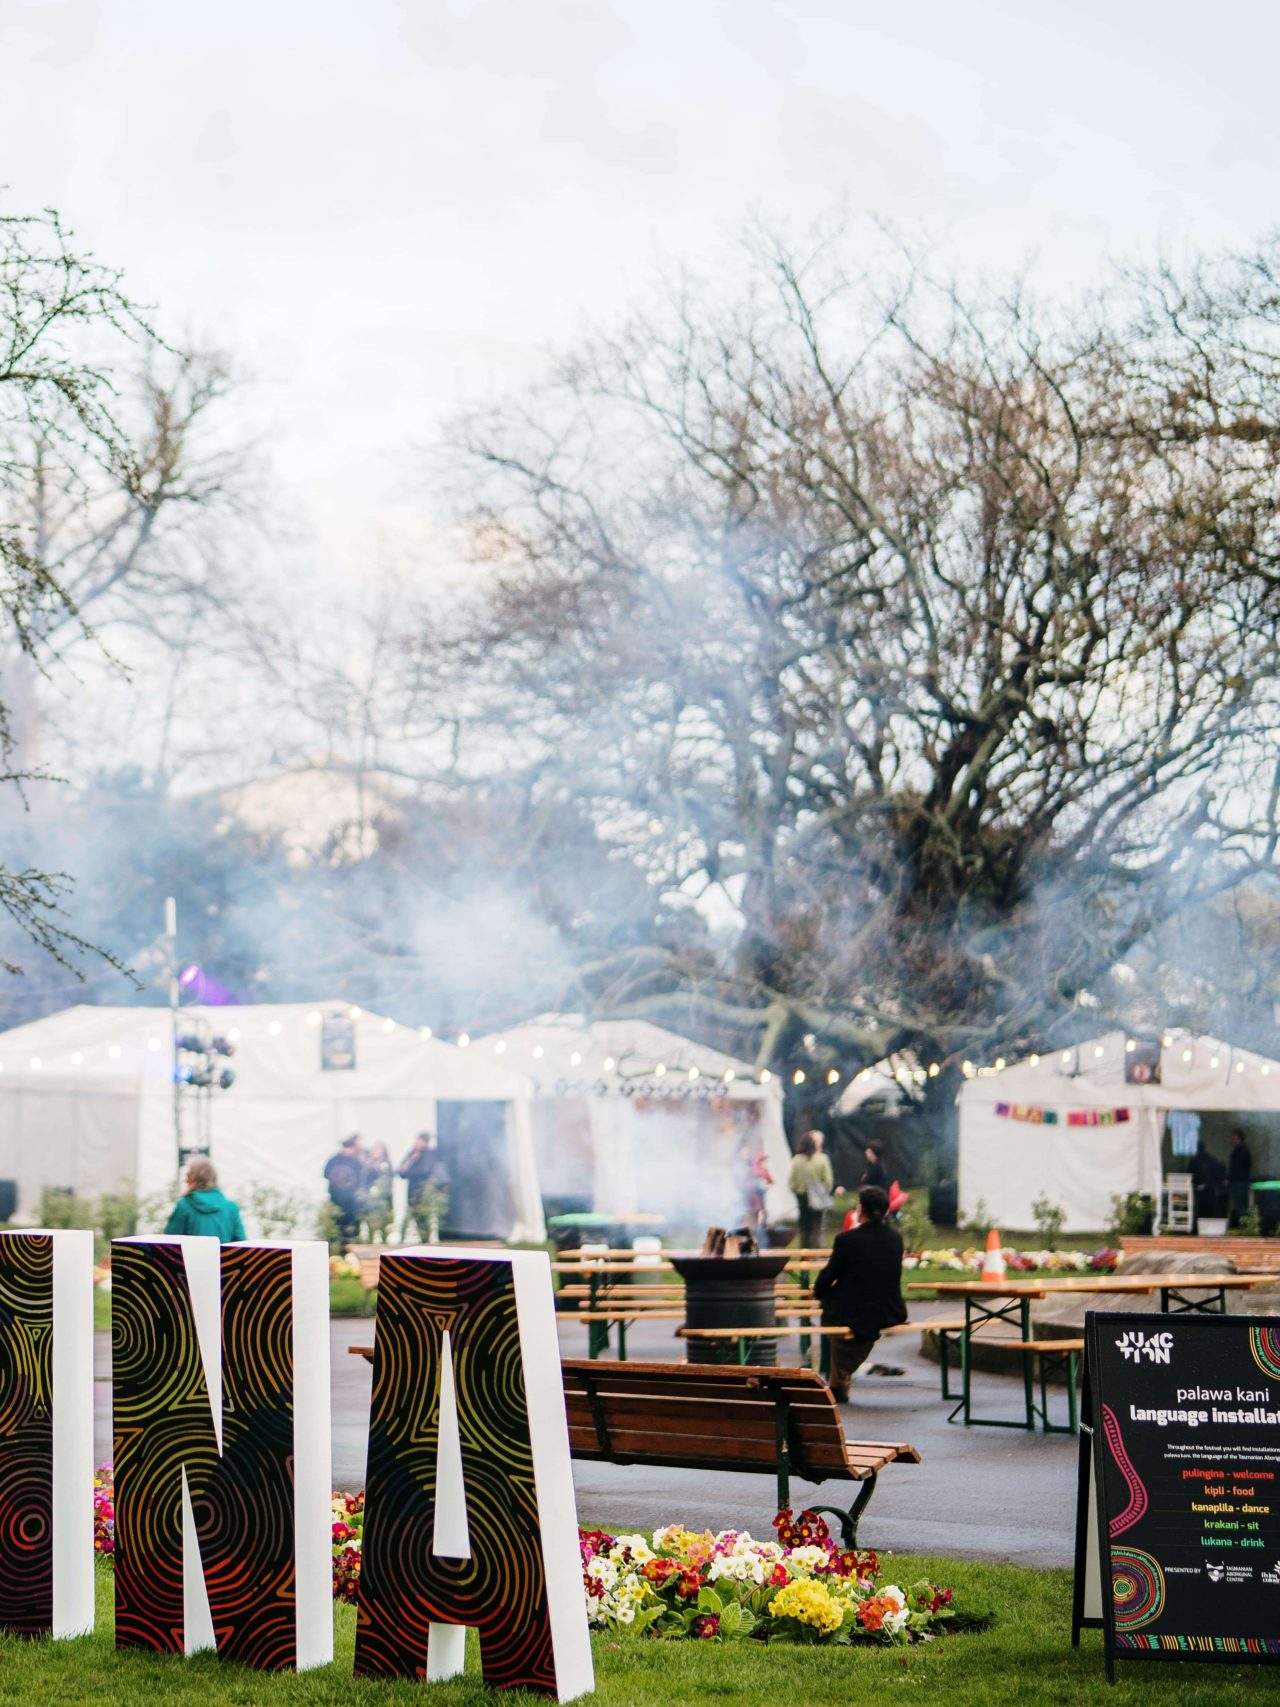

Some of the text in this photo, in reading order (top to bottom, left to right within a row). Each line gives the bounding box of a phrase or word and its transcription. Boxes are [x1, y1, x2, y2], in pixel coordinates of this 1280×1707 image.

[1115, 1331, 1174, 1348] JUNC
[1177, 1386, 1270, 1403] palawa kani
[1129, 1404, 1208, 1427] language
[1182, 1468, 1225, 1480] pulingina
[1233, 1469, 1274, 1480] welcome
[1205, 1486, 1224, 1497] kipli
[1233, 1486, 1254, 1496] food
[1192, 1502, 1233, 1514] kanaplila
[1242, 1504, 1269, 1513] dance
[1204, 1520, 1239, 1529] krakani
[1247, 1521, 1259, 1530] sit
[1201, 1537, 1232, 1546] lukana
[1241, 1538, 1264, 1547] drink
